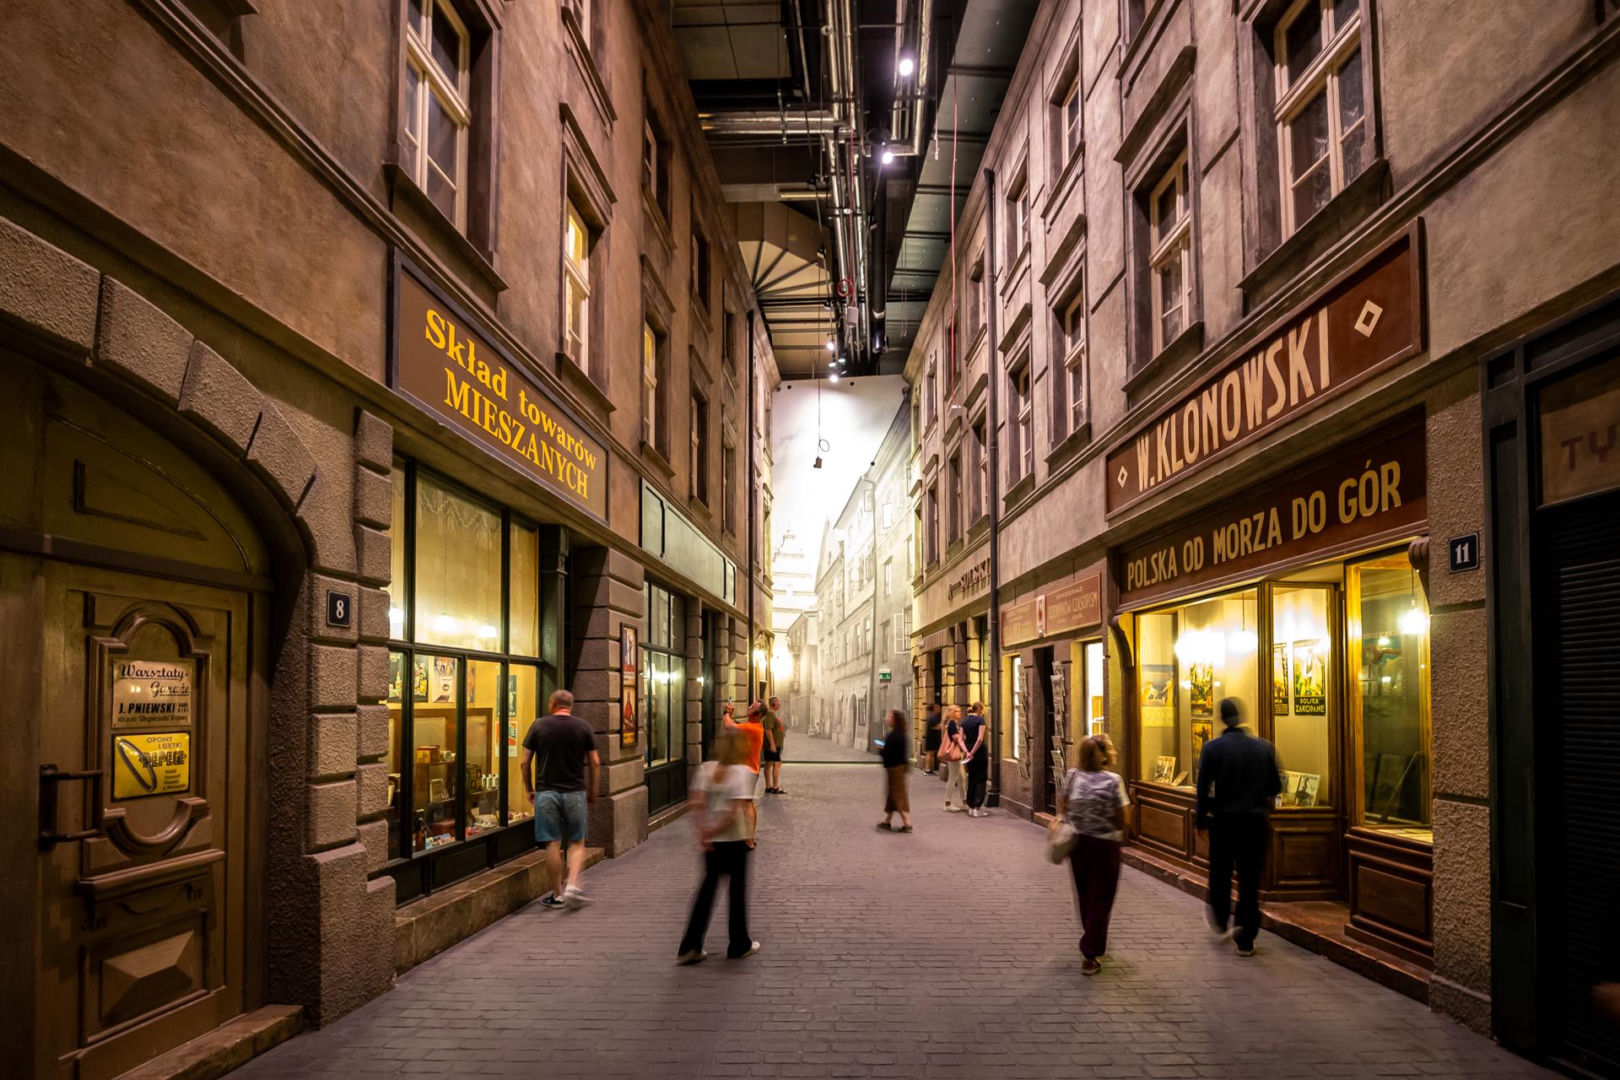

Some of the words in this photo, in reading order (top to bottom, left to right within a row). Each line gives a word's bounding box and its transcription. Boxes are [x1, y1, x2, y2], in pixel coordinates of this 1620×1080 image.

[426, 309, 508, 401] Skład
[518, 390, 597, 470] towarów
[444, 367, 588, 499] MIESZANYCH
[1127, 547, 1178, 591] POLSKA
[1183, 536, 1204, 574] OD
[1213, 506, 1283, 565] MORZA
[1292, 490, 1327, 540] DO
[1338, 459, 1402, 524] GÓR
[1454, 542, 1470, 564] 11
[336, 600, 344, 619] 8
[128, 702, 176, 714] PNIEWSKI
